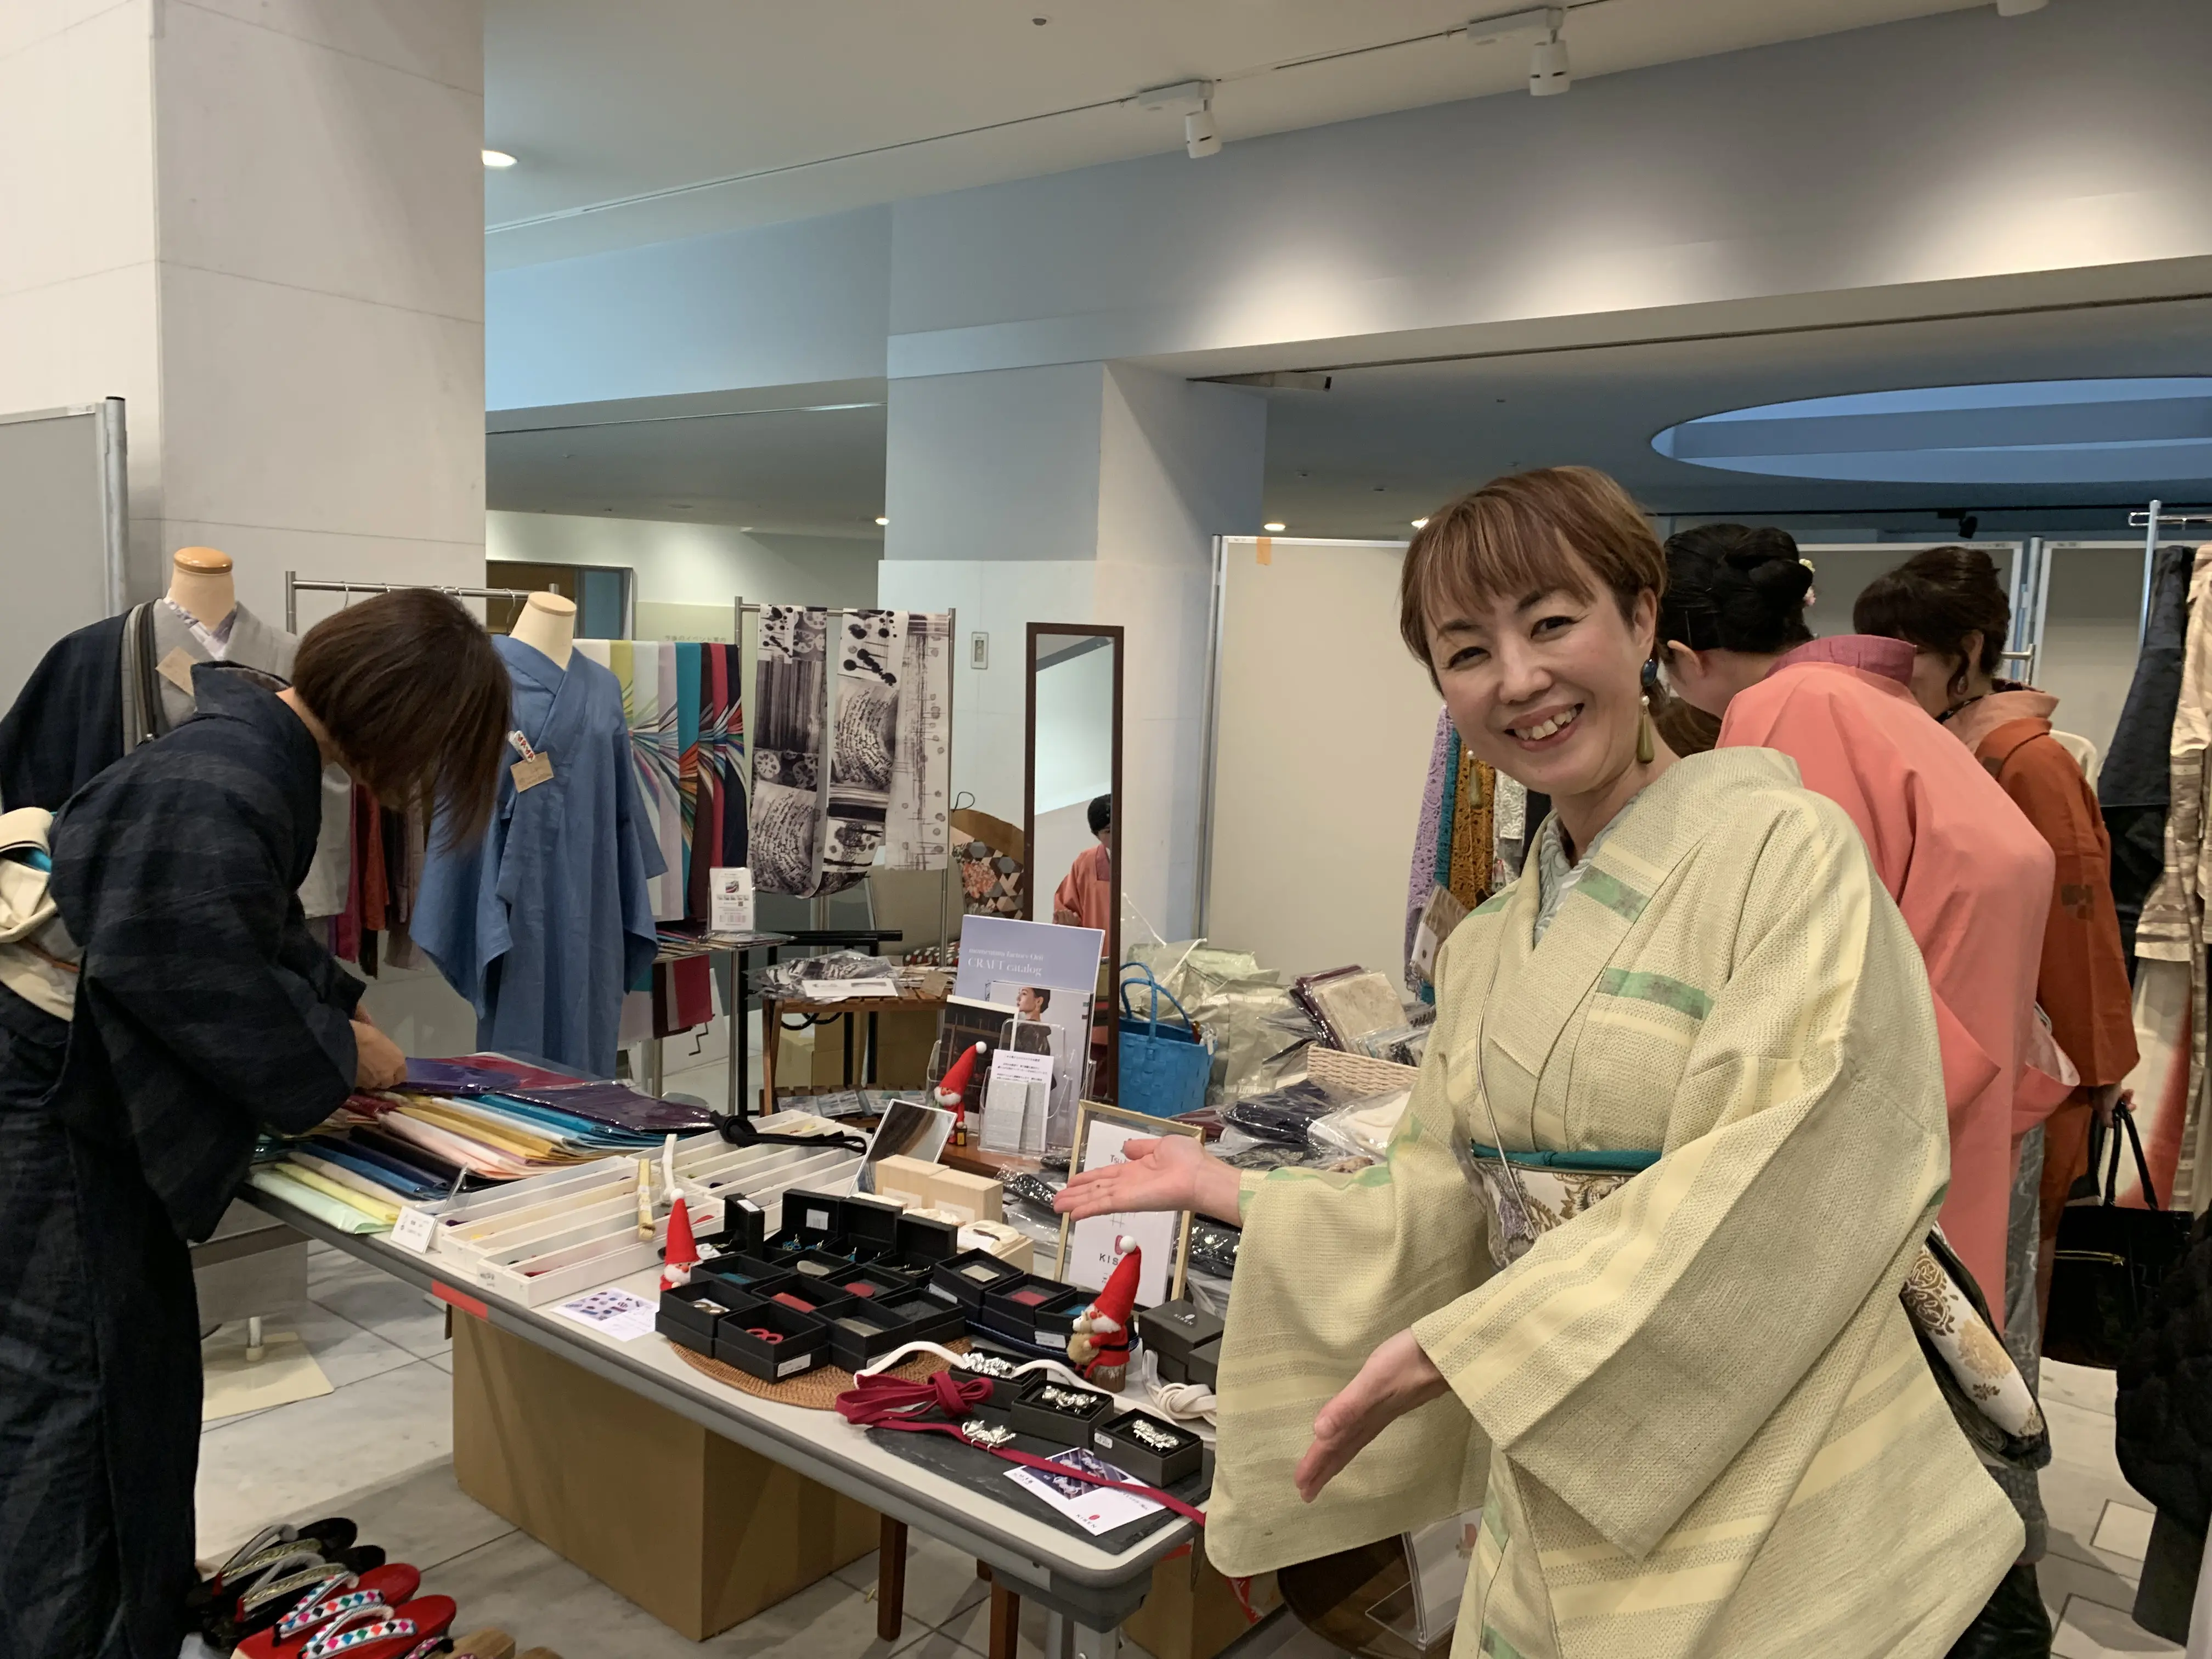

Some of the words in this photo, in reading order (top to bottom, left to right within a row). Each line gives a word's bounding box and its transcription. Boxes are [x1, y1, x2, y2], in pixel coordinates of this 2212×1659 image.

[968, 957, 1006, 970] CRAFT
[1006, 964, 1043, 977] catalog
[1099, 1253, 1119, 1266] KIS
